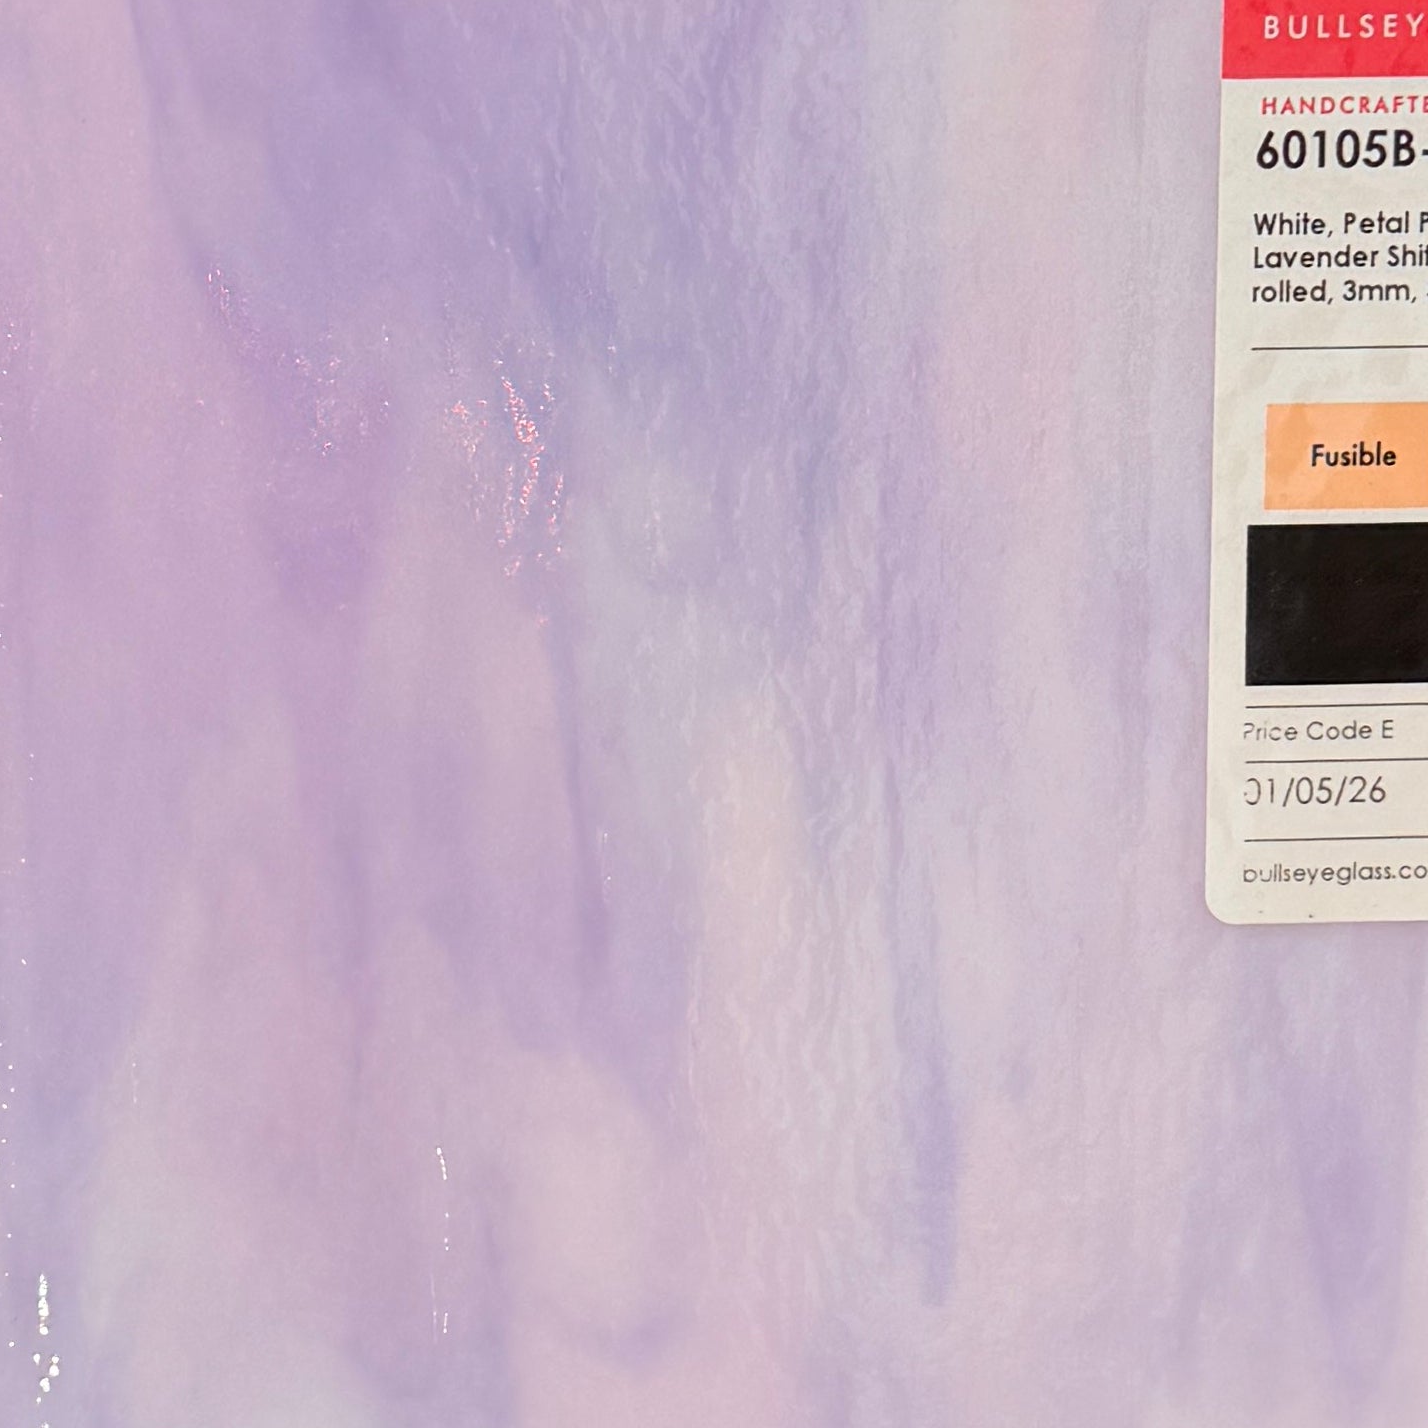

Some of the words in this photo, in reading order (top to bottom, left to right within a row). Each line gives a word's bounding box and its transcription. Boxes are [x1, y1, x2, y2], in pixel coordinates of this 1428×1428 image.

[1253, 211, 1333, 238] White,
[1343, 210, 1410, 234] Petal
[1254, 244, 1380, 269] Lavender
[1252, 278, 1334, 305] rolled,
[1342, 279, 1417, 304] 3mm,
[1311, 440, 1397, 467] Fusible
[1243, 722, 1299, 742] Price
[1306, 719, 1373, 741] Code
[1381, 719, 1394, 739] E
[1245, 775, 1387, 808] 01/05/26
